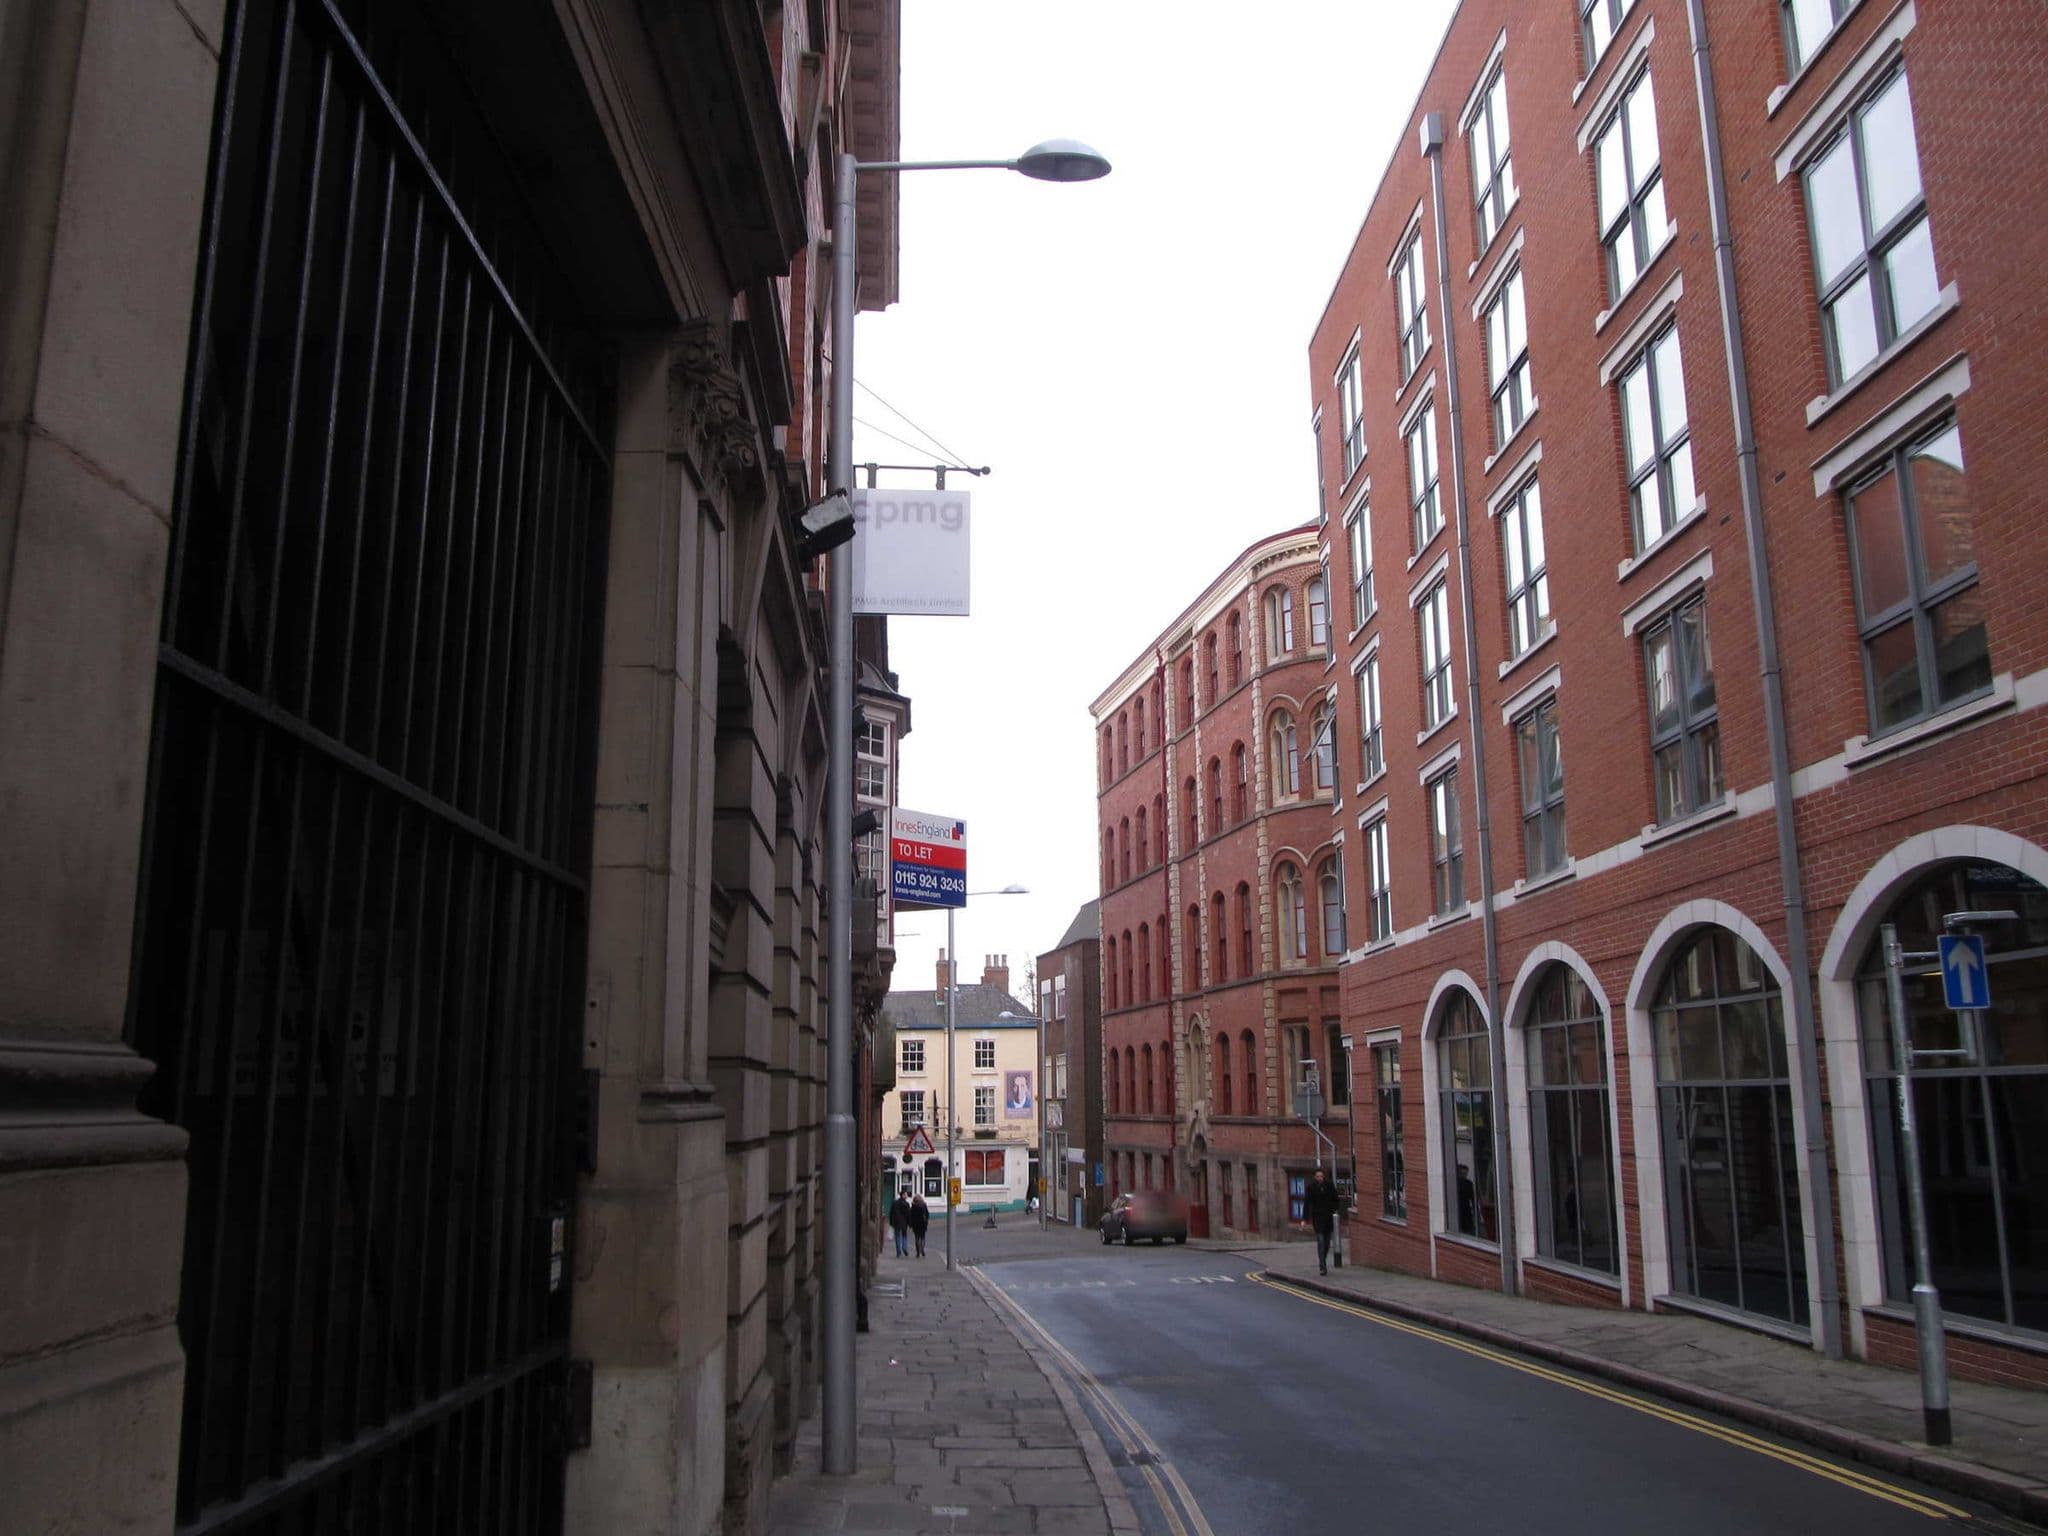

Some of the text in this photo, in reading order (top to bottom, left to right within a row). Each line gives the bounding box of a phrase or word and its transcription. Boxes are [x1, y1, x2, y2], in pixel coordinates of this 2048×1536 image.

[898, 842, 933, 860] TO LET
[895, 870, 965, 893] 0115 924 3243
